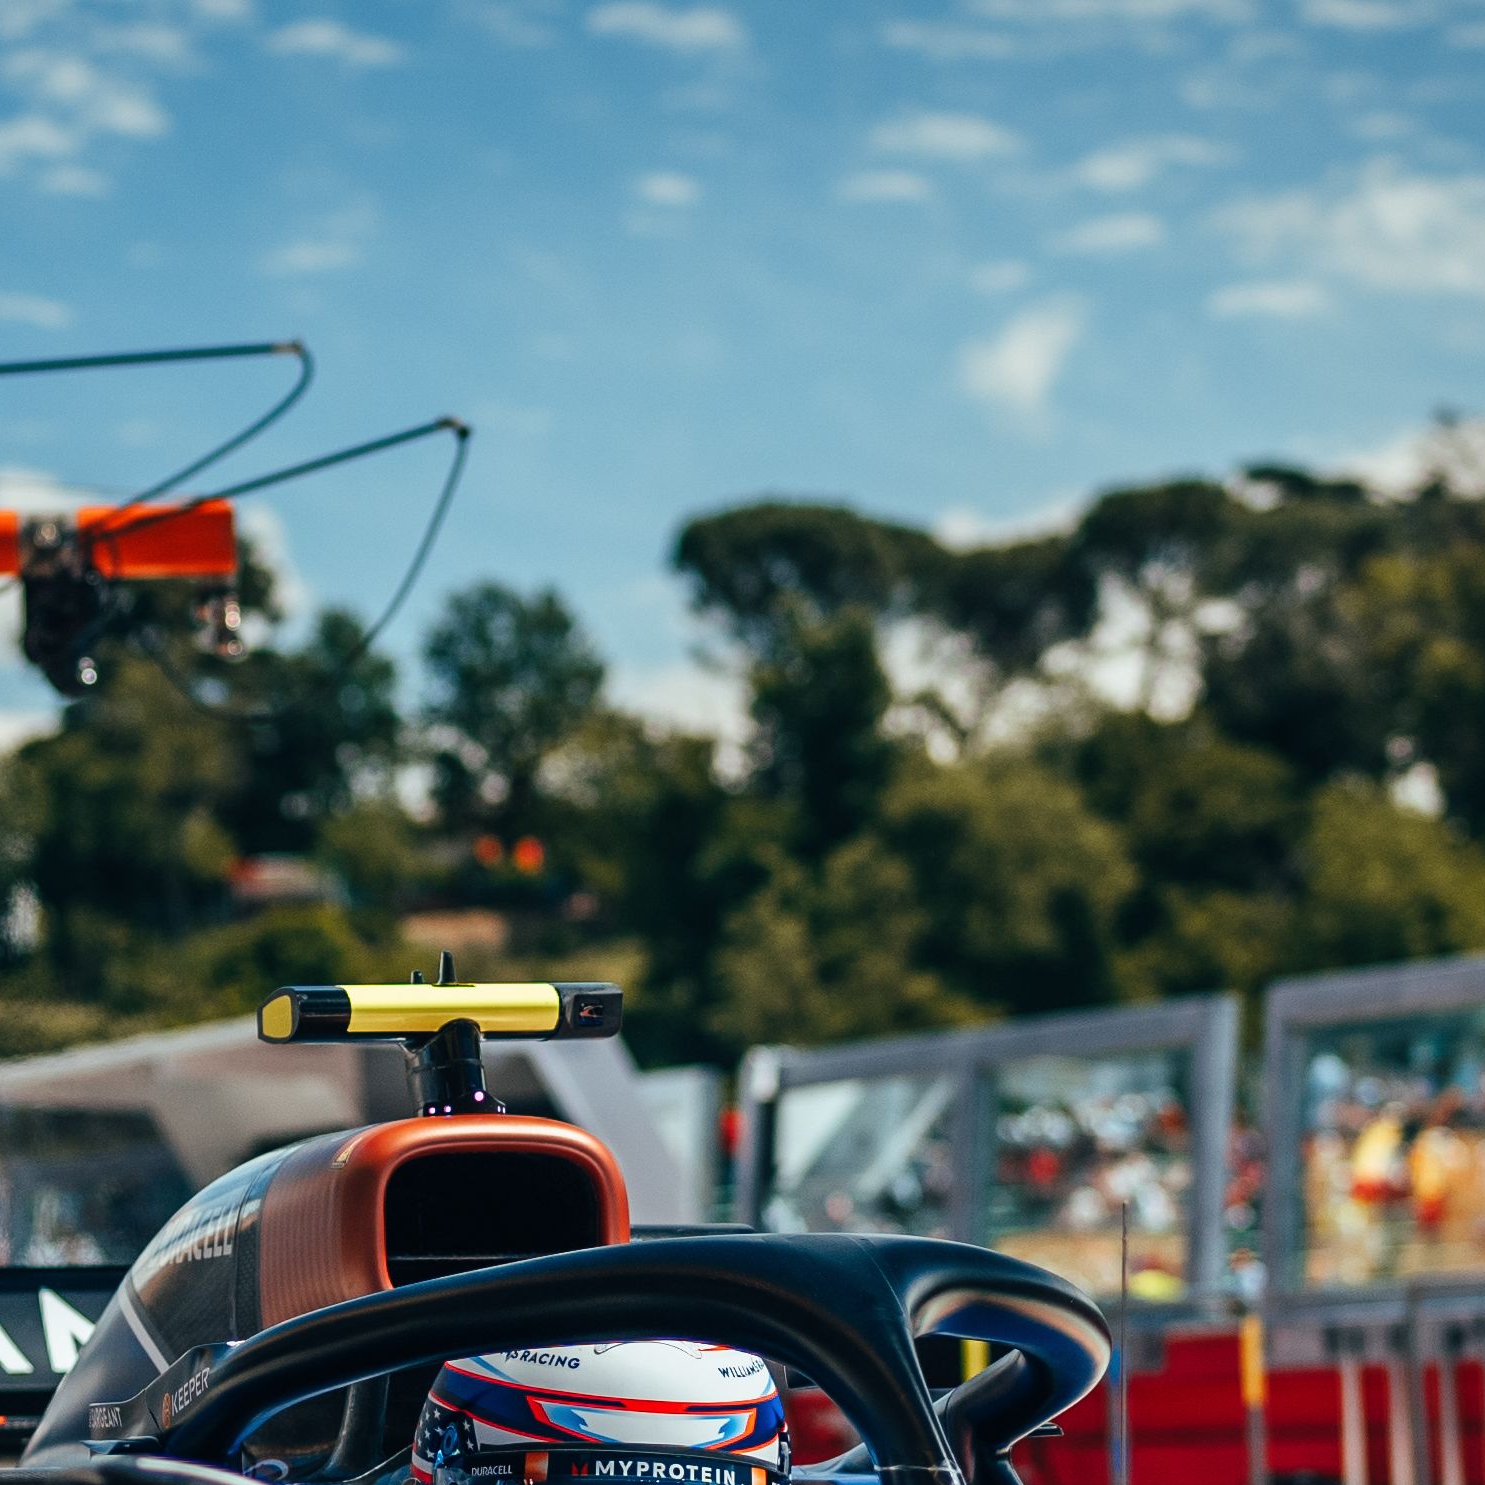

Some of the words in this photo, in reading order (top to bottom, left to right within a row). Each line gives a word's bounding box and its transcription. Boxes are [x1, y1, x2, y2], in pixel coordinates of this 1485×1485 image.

[519, 1350, 580, 1370] RACING
[171, 1367, 210, 1417] KEEPER
[471, 1464, 513, 1477] DURACELL
